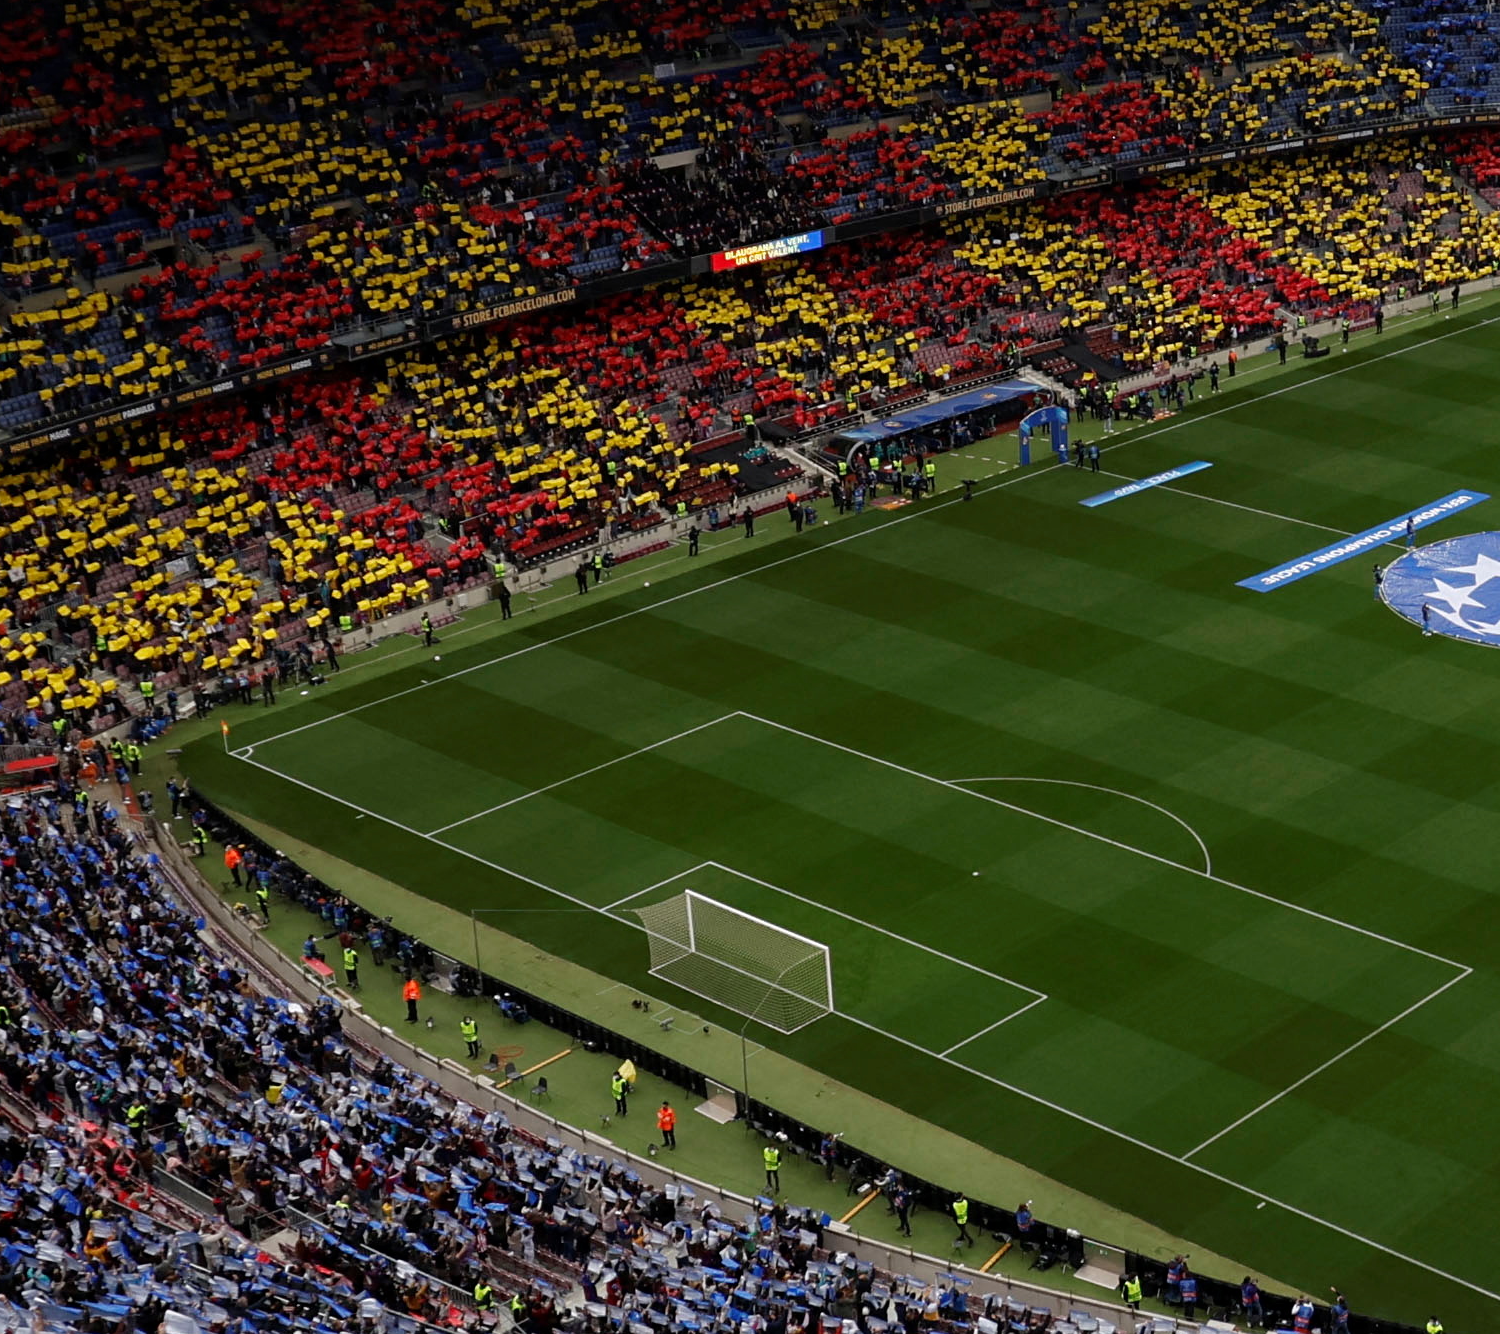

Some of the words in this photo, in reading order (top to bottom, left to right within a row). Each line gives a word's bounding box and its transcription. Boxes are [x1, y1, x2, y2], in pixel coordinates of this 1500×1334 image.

[945, 187, 1035, 214] STORE.FCBARCELONA.COM
[725, 242, 773, 260] BLAUGRANA
[774, 240, 786, 250] AL
[735, 254, 748, 265] UN
[749, 250, 766, 263] CRIT
[462, 288, 576, 327] STORE.FCBARCELONA.COM
[1442, 495, 1473, 510] UEFA
[1389, 501, 1446, 533] WOMN'S
[1313, 528, 1391, 563] CHAMPIONS
[1261, 561, 1315, 586] LEAGUE
